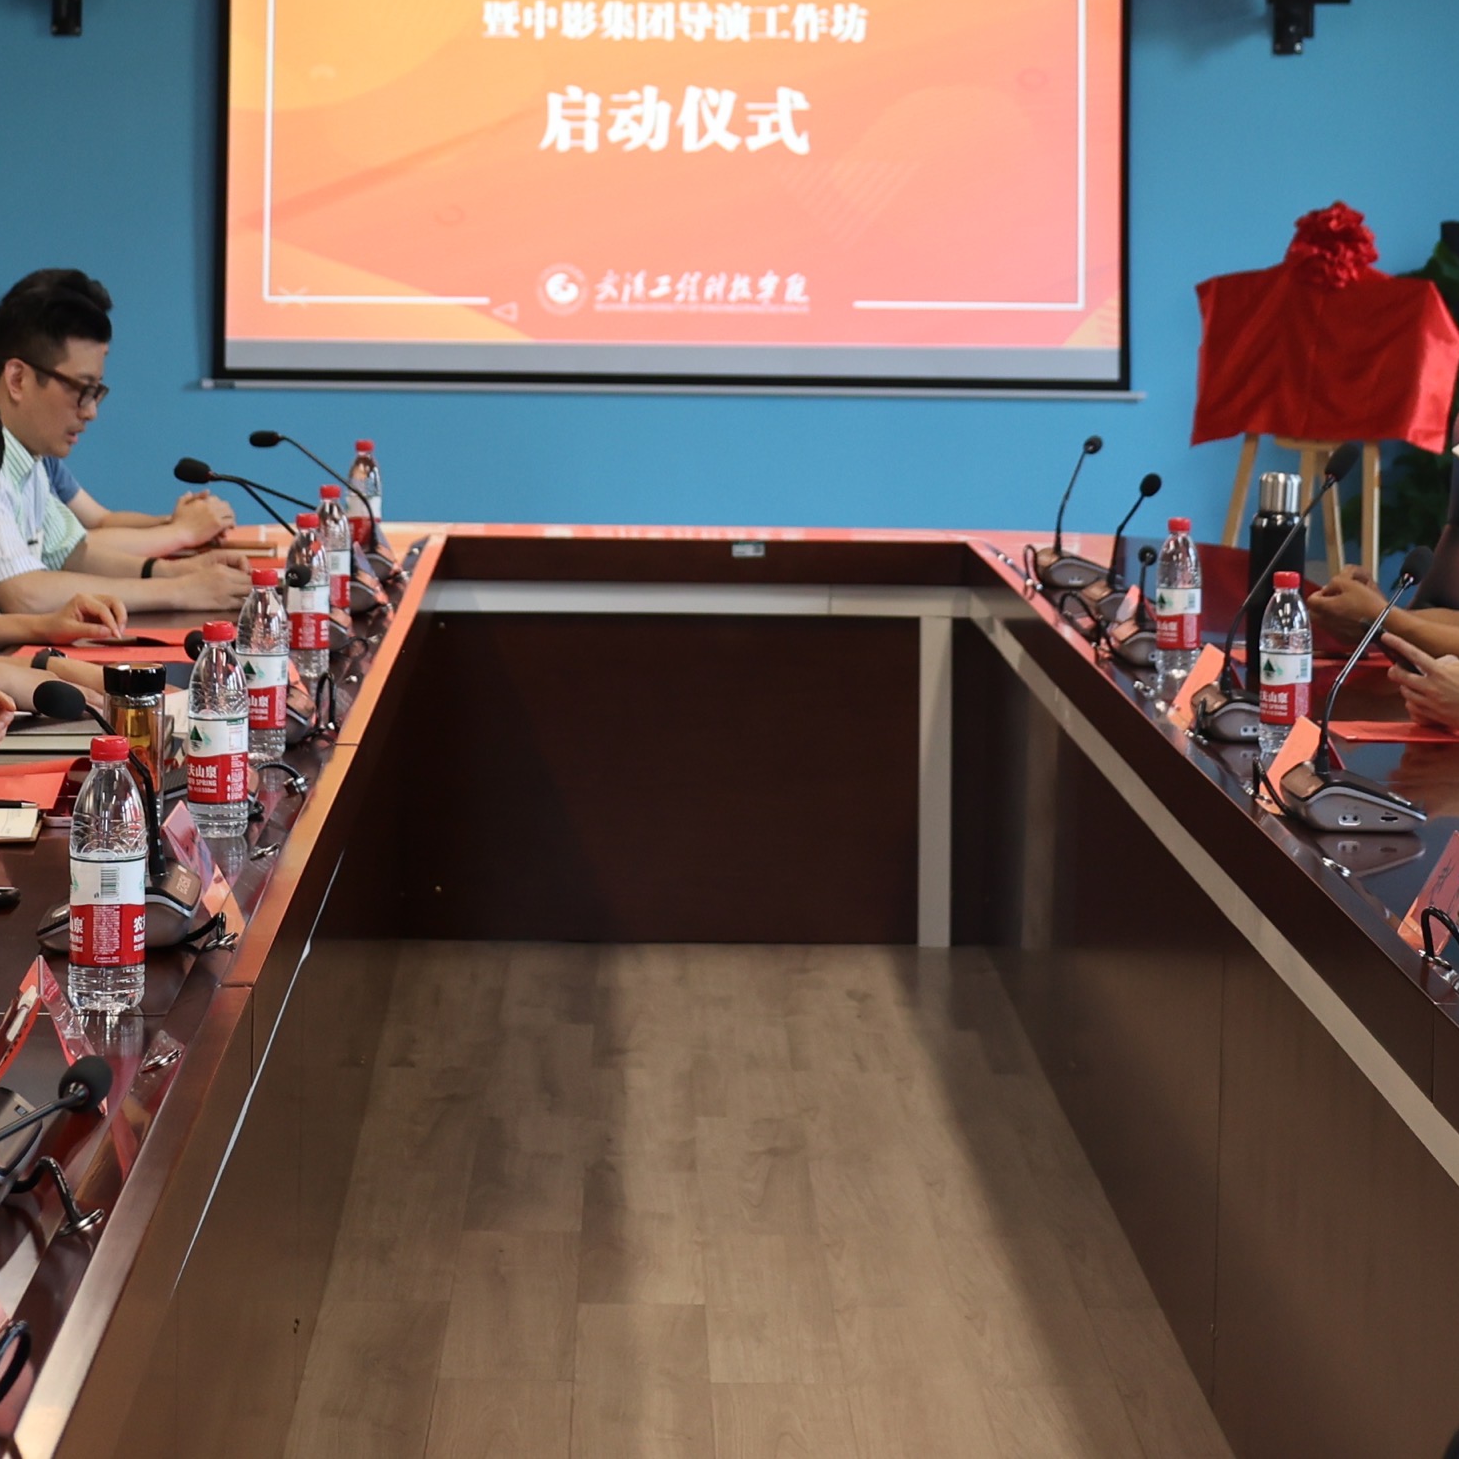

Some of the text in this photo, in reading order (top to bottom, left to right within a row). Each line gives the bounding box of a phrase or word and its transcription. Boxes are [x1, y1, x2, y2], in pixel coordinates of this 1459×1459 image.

[483, 0, 868, 43] 暨中影集团导演工作坊
[539, 85, 811, 155] 启动仪式
